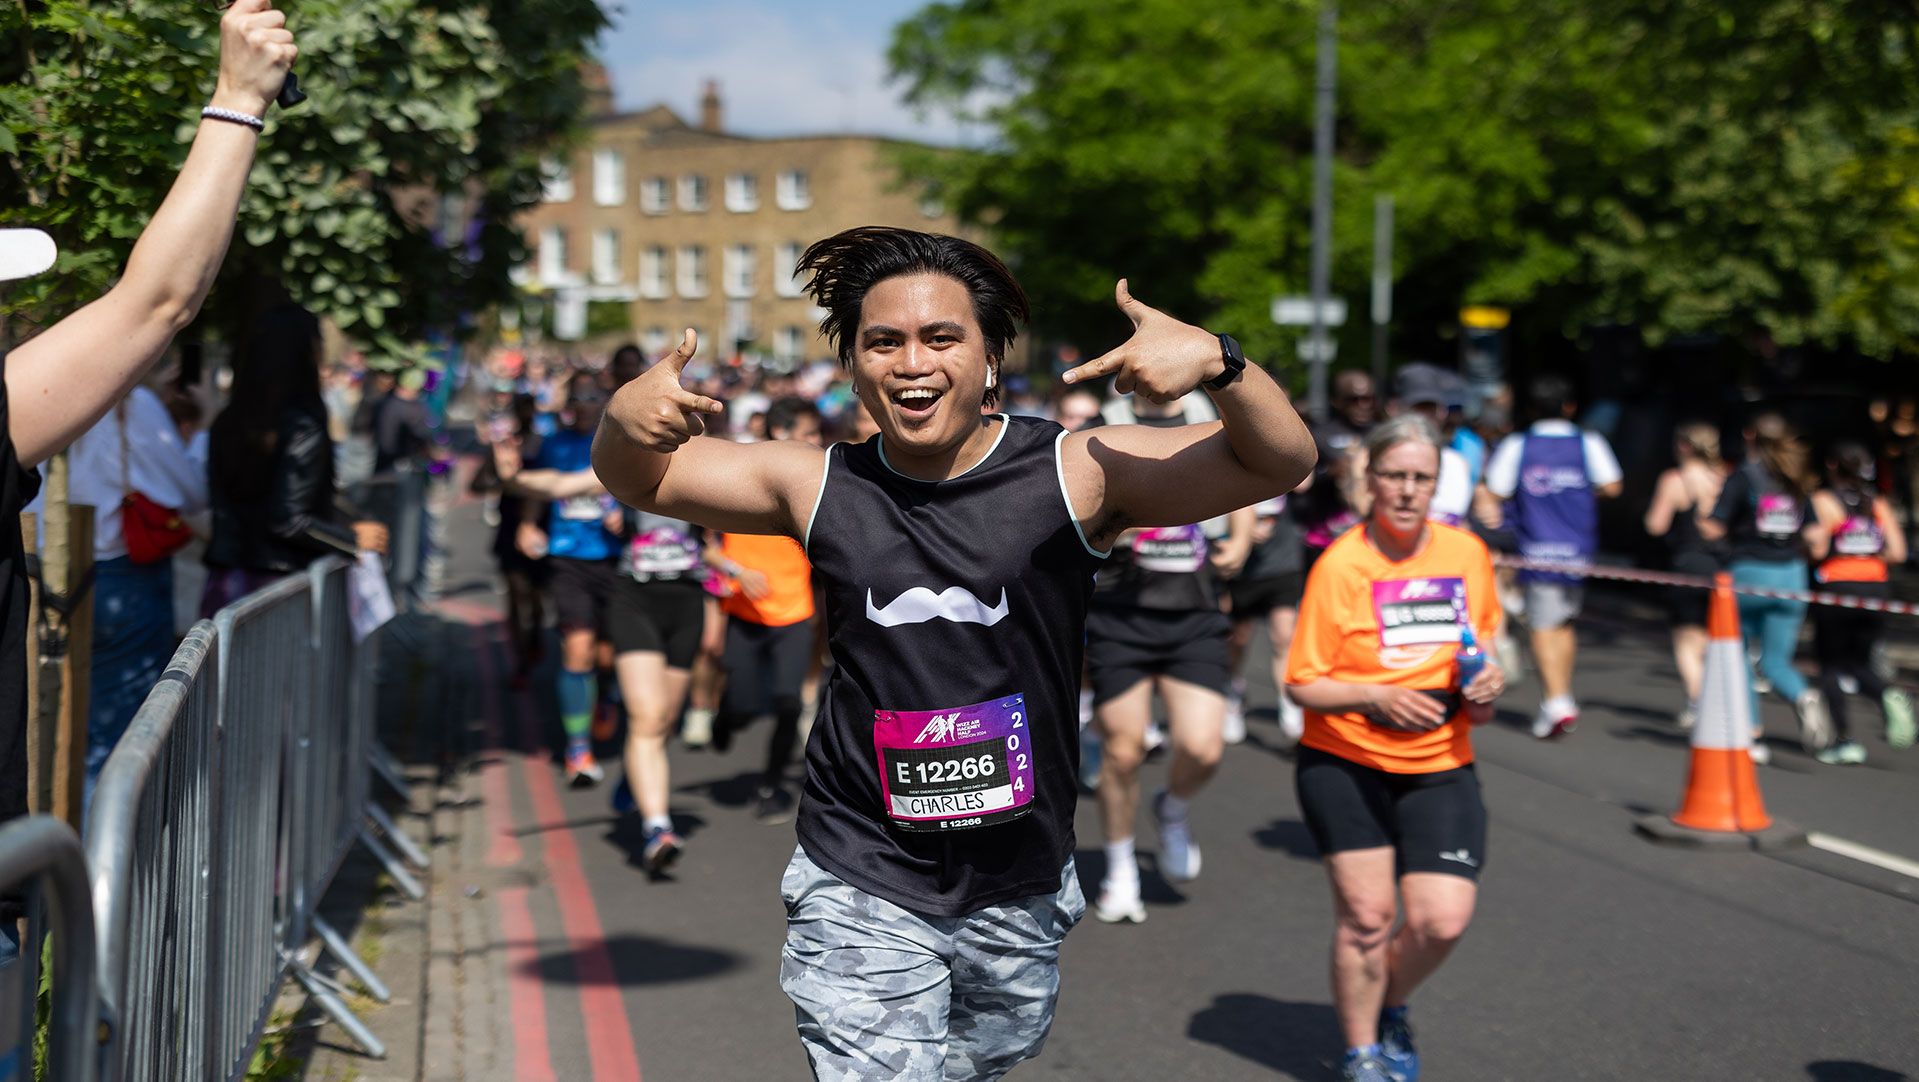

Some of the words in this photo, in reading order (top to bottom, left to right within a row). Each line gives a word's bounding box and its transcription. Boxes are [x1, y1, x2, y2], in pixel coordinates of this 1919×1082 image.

[896, 762, 911, 784] E
[915, 754, 996, 783] 12266
[911, 792, 984, 814] CHARLES
[950, 818, 982, 828] 12266
